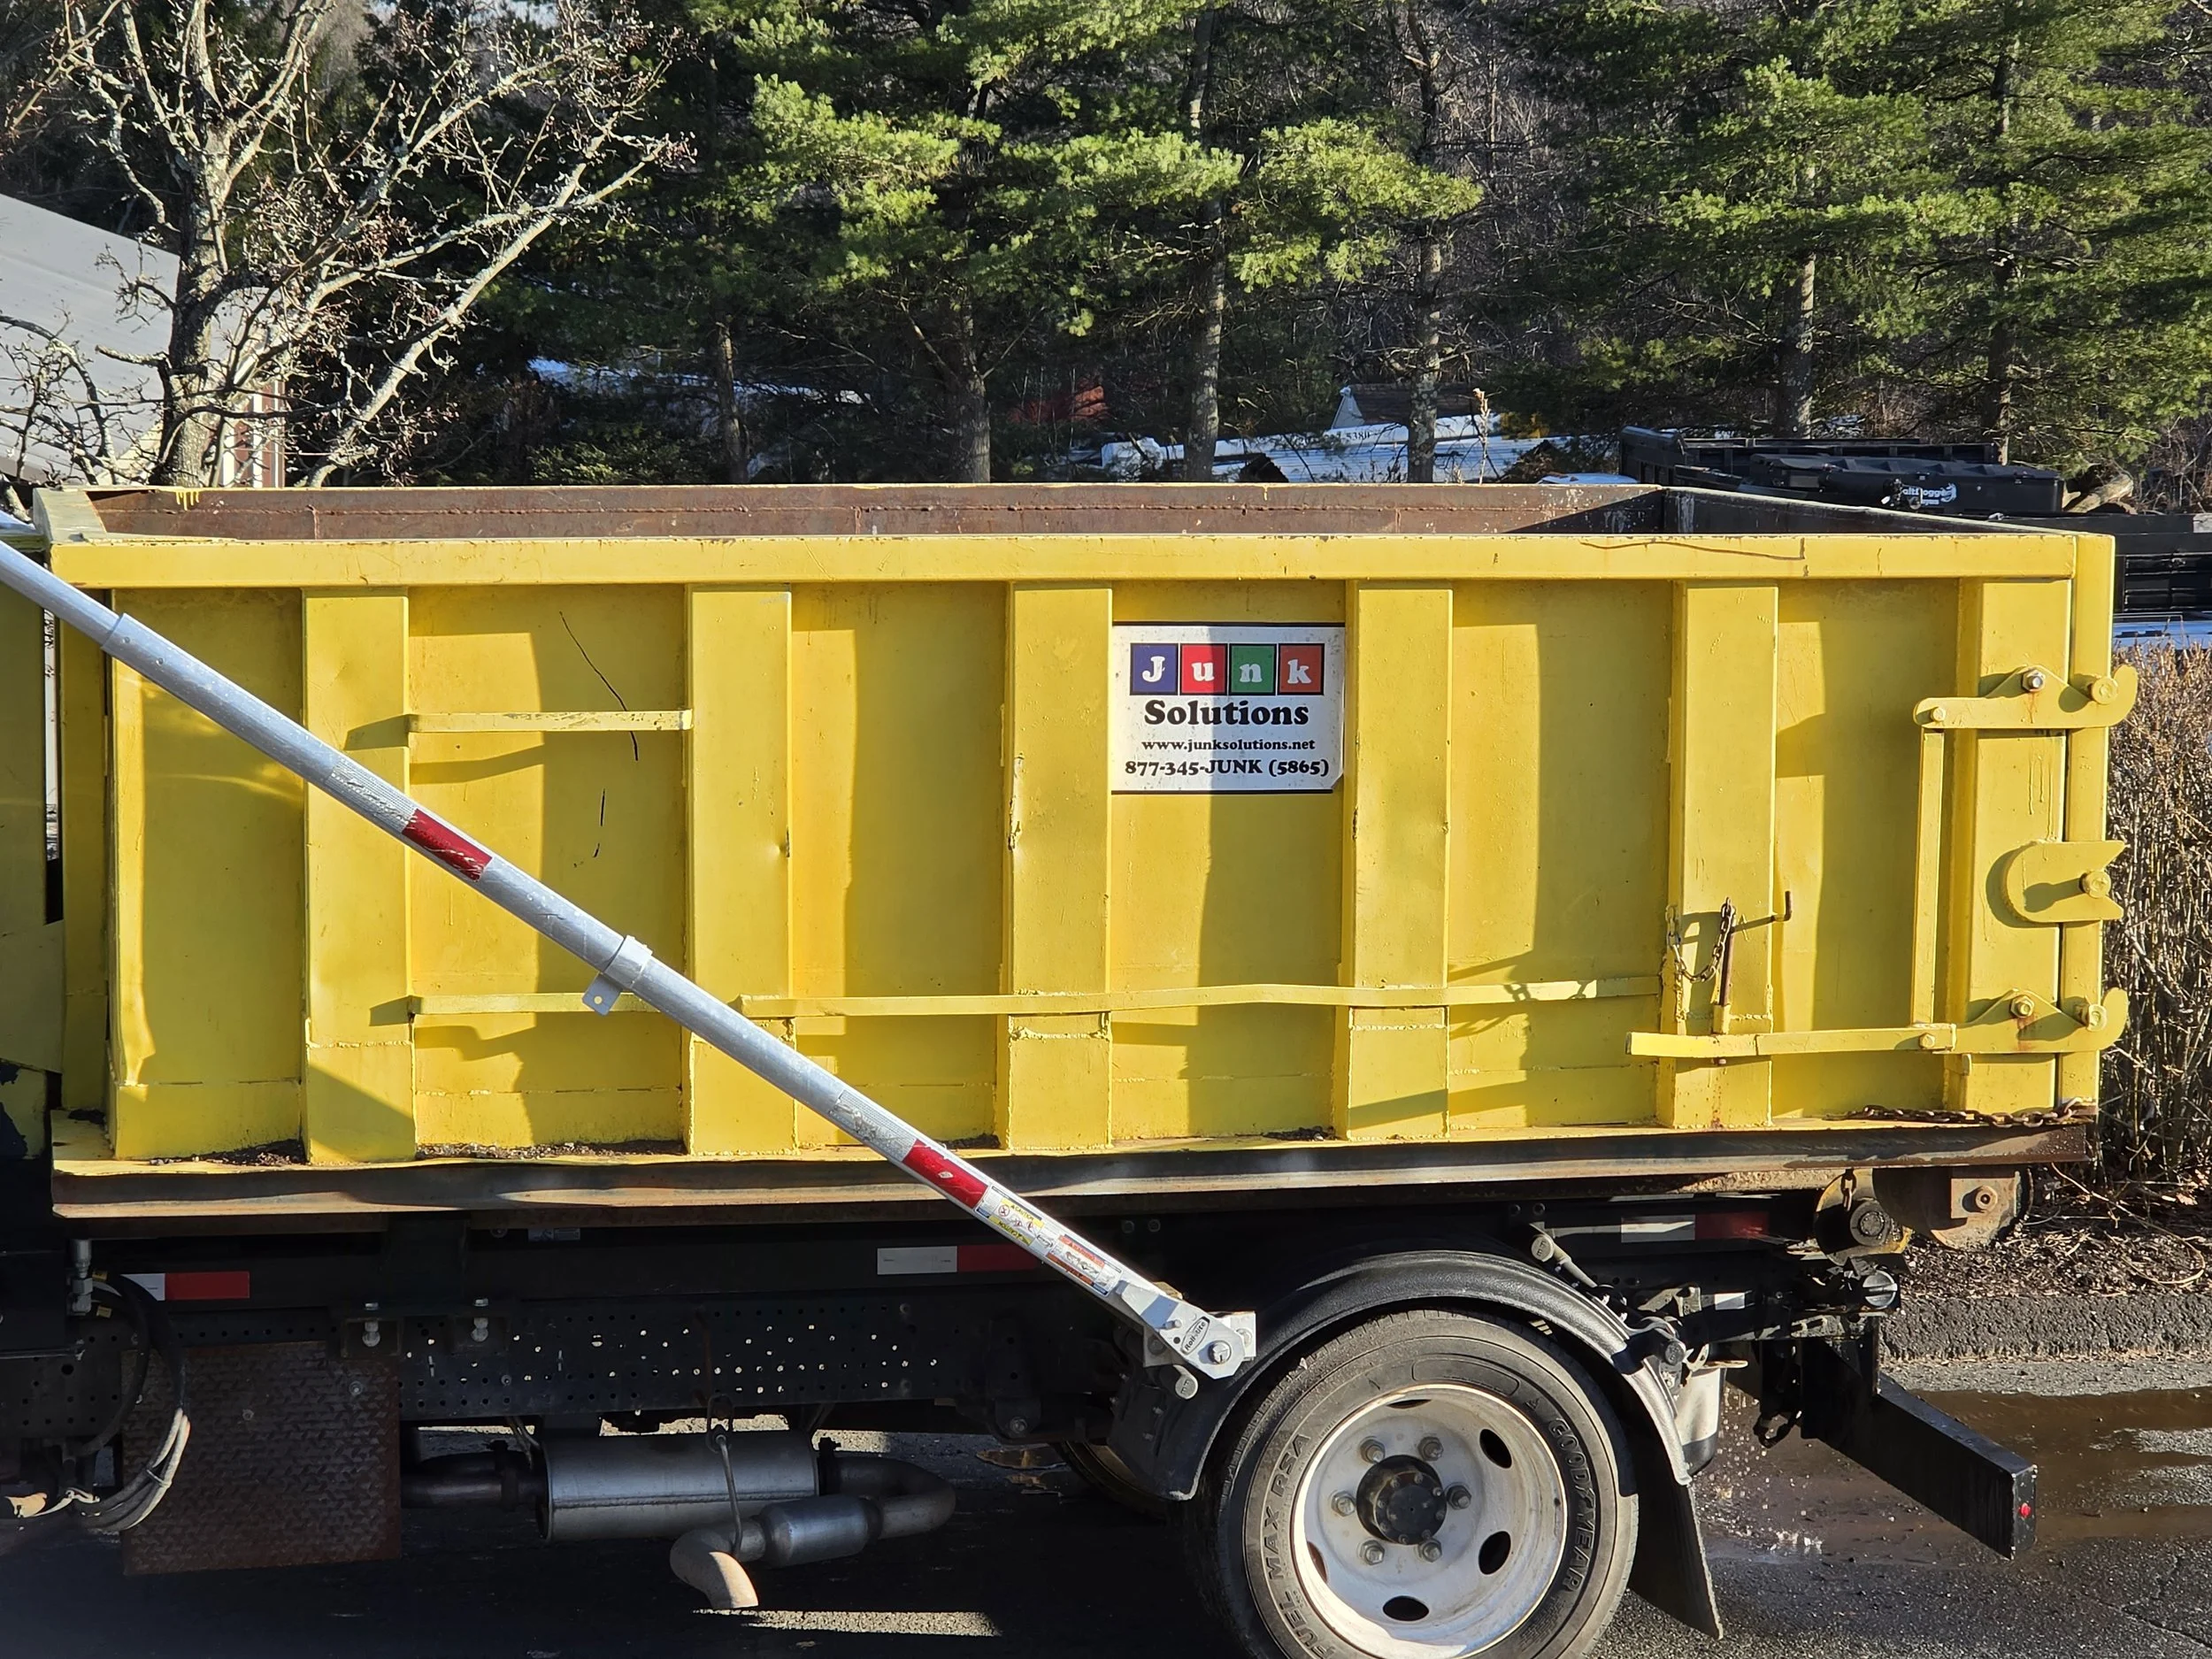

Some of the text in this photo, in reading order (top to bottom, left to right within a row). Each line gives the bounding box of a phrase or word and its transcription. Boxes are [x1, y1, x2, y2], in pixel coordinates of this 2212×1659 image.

[1141, 656, 1312, 684] Junk
[1144, 700, 1310, 726] Solutions
[1141, 739, 1316, 752] www.junksolutions.net
[1125, 759, 1330, 777] 877-345-JUNK (5865)
[1015, 1205, 1034, 1221] CAUTION
[1271, 1433, 1311, 1498] RSA
[1548, 1417, 1596, 1593] GOODYEAR
[1264, 1506, 1285, 1580] MAX
[1279, 1591, 1337, 1659] FUEL
